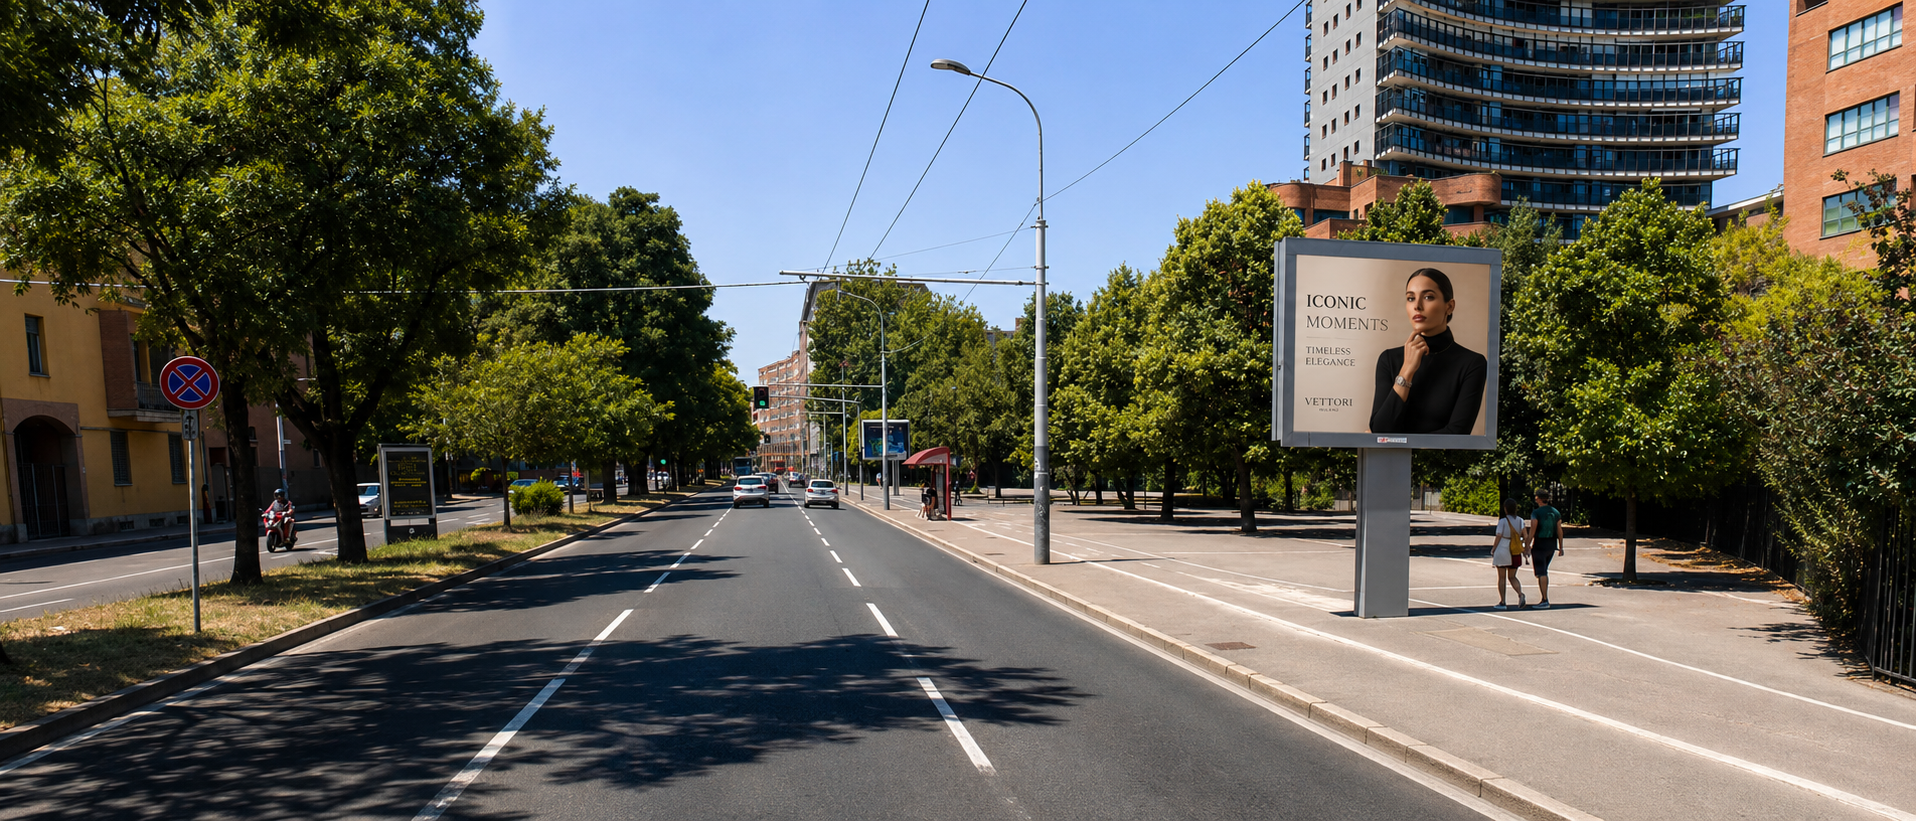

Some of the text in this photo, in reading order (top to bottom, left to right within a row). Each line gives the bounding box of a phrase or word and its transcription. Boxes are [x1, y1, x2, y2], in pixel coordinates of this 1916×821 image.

[1306, 294, 1367, 310] ICONIC
[1306, 315, 1389, 331] MOMENTS
[1305, 346, 1351, 355] TIMELESS
[1305, 357, 1355, 366] ELEGANCE
[1305, 397, 1352, 406] VETTORI
